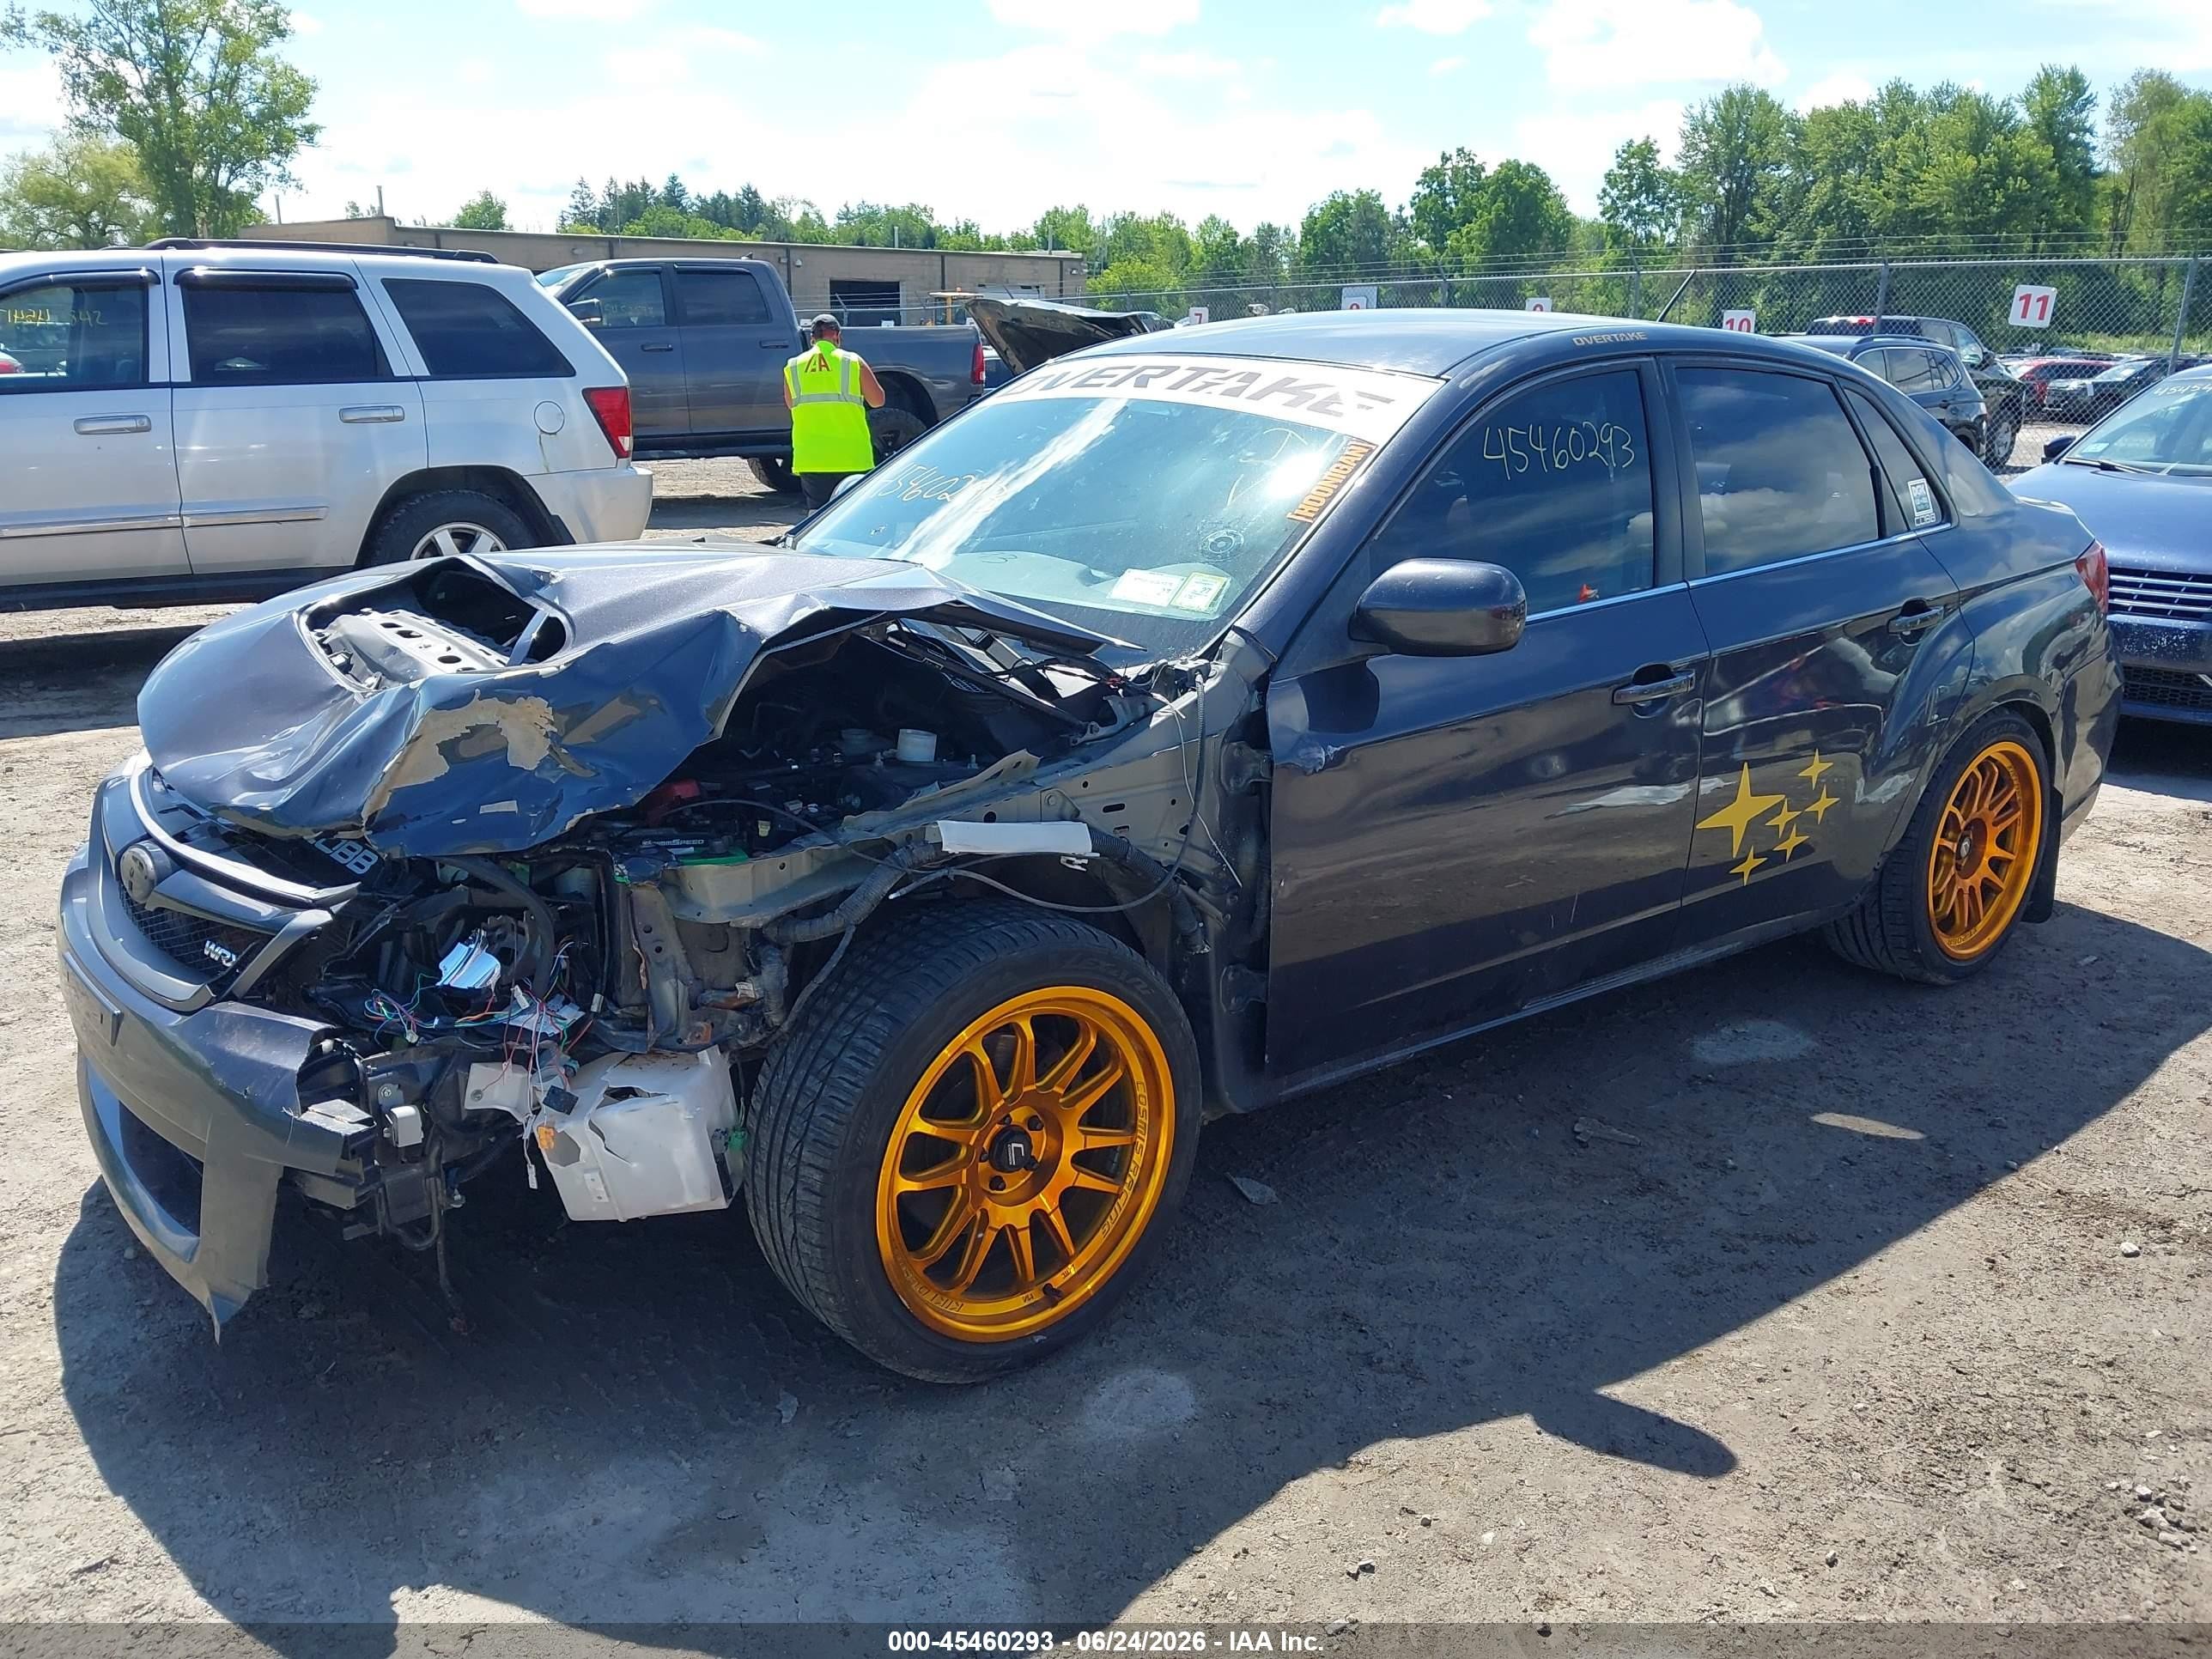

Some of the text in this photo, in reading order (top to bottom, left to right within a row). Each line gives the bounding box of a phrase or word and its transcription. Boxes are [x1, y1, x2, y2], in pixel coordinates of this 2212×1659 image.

[1194, 313, 1203, 325] 7
[2019, 293, 2051, 321] 11
[1725, 317, 1752, 331] 10
[1571, 331, 1648, 346] OVERTAKE
[1000, 365, 1395, 418] OVERTAKE
[1483, 421, 1635, 480] 45460293
[1101, 1080, 1147, 1238] COSMIS RACING
